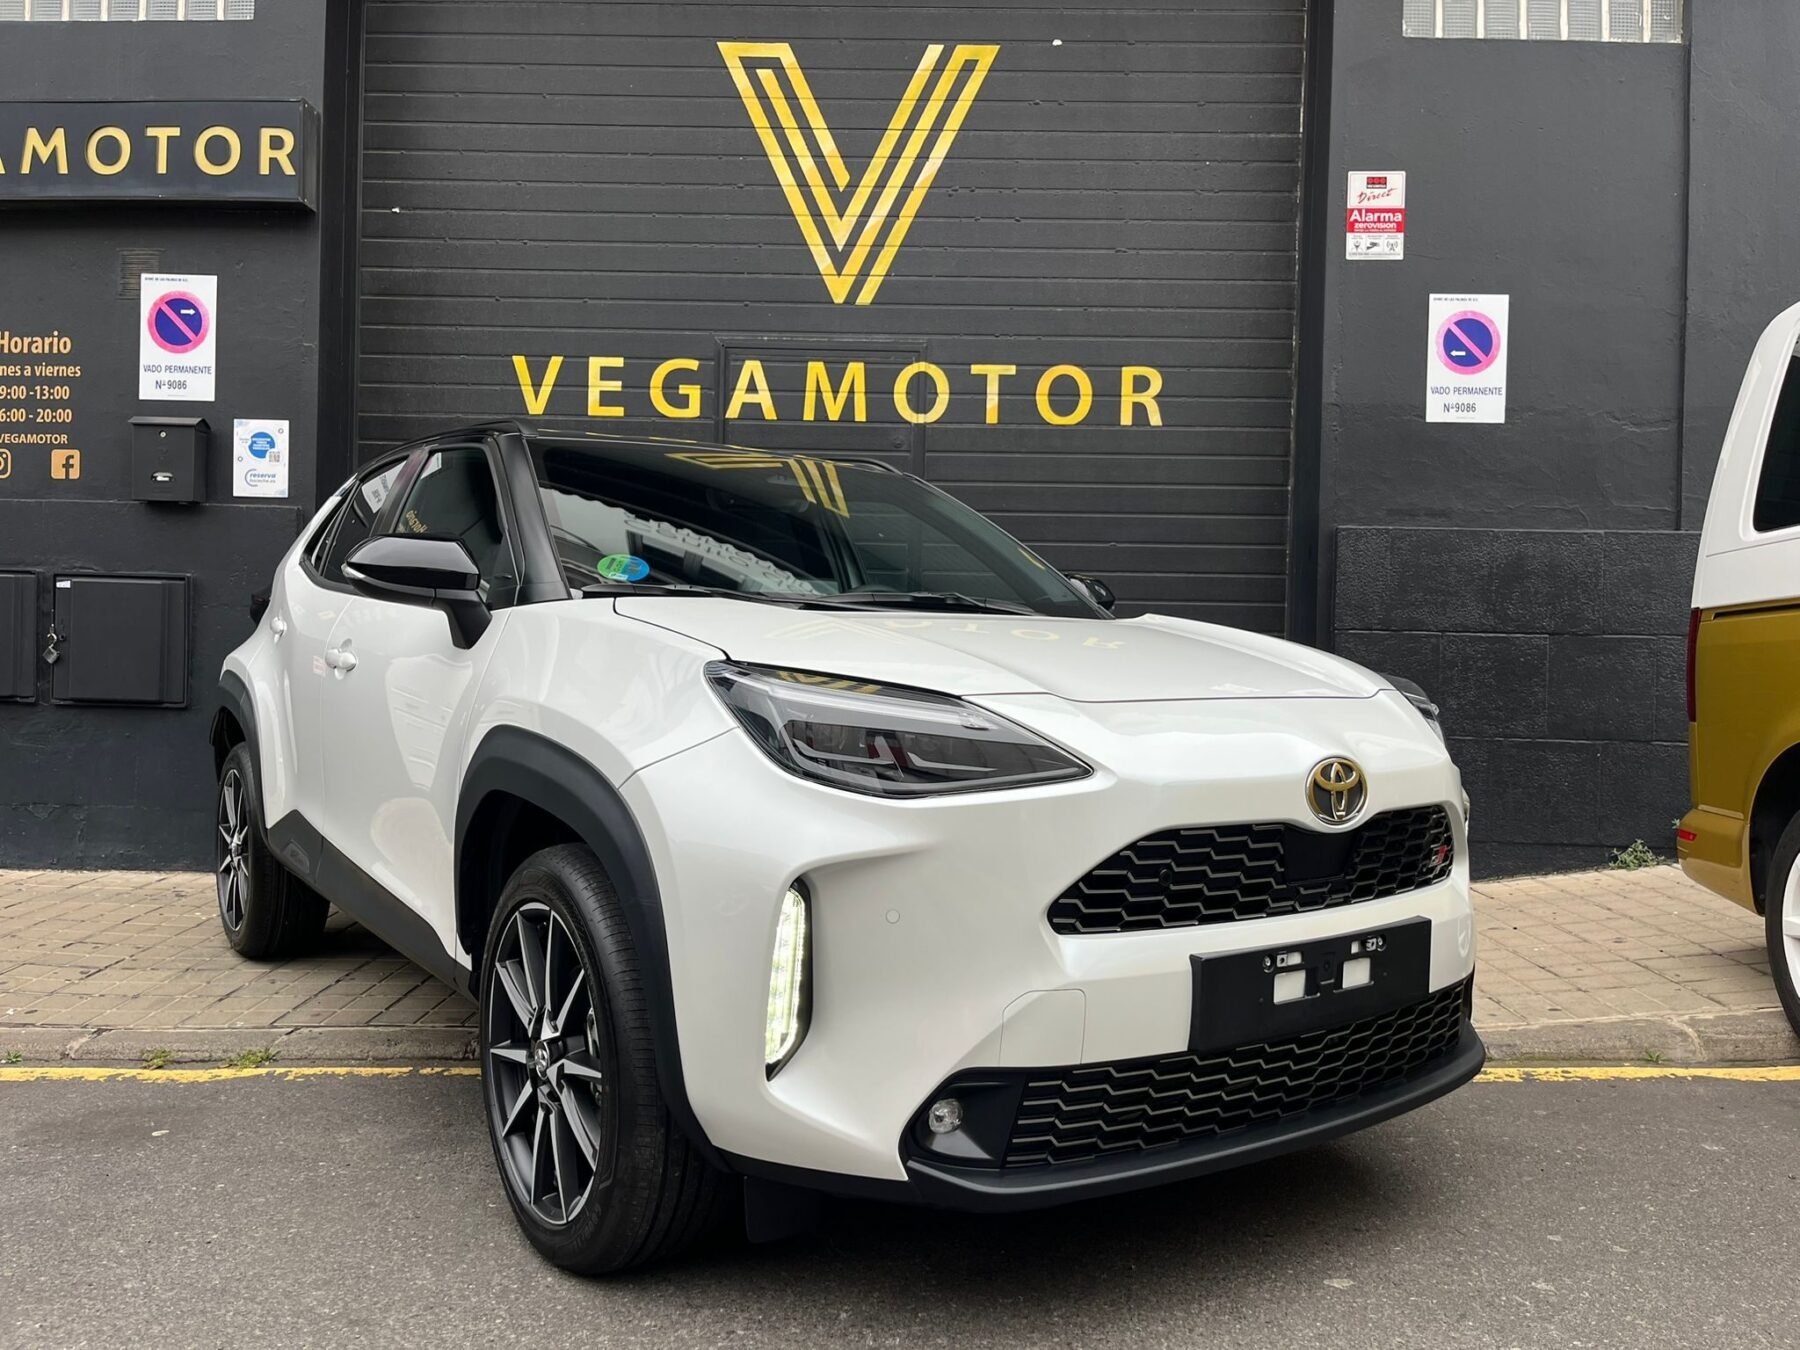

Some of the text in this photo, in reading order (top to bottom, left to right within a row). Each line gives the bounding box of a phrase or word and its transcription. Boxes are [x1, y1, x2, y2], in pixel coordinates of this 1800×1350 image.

[0, 125, 297, 176] MOTOR
[1349, 209, 1403, 222] Alarma
[0, 330, 72, 354] Horario
[23, 365, 32, 377] a
[34, 362, 81, 377] viernes
[143, 364, 212, 375] VADO PERMANENTE
[511, 354, 1164, 427] VEGAMOTOR
[1430, 386, 1503, 396] VADO PERMANENTE
[36, 408, 73, 423] 20:00
